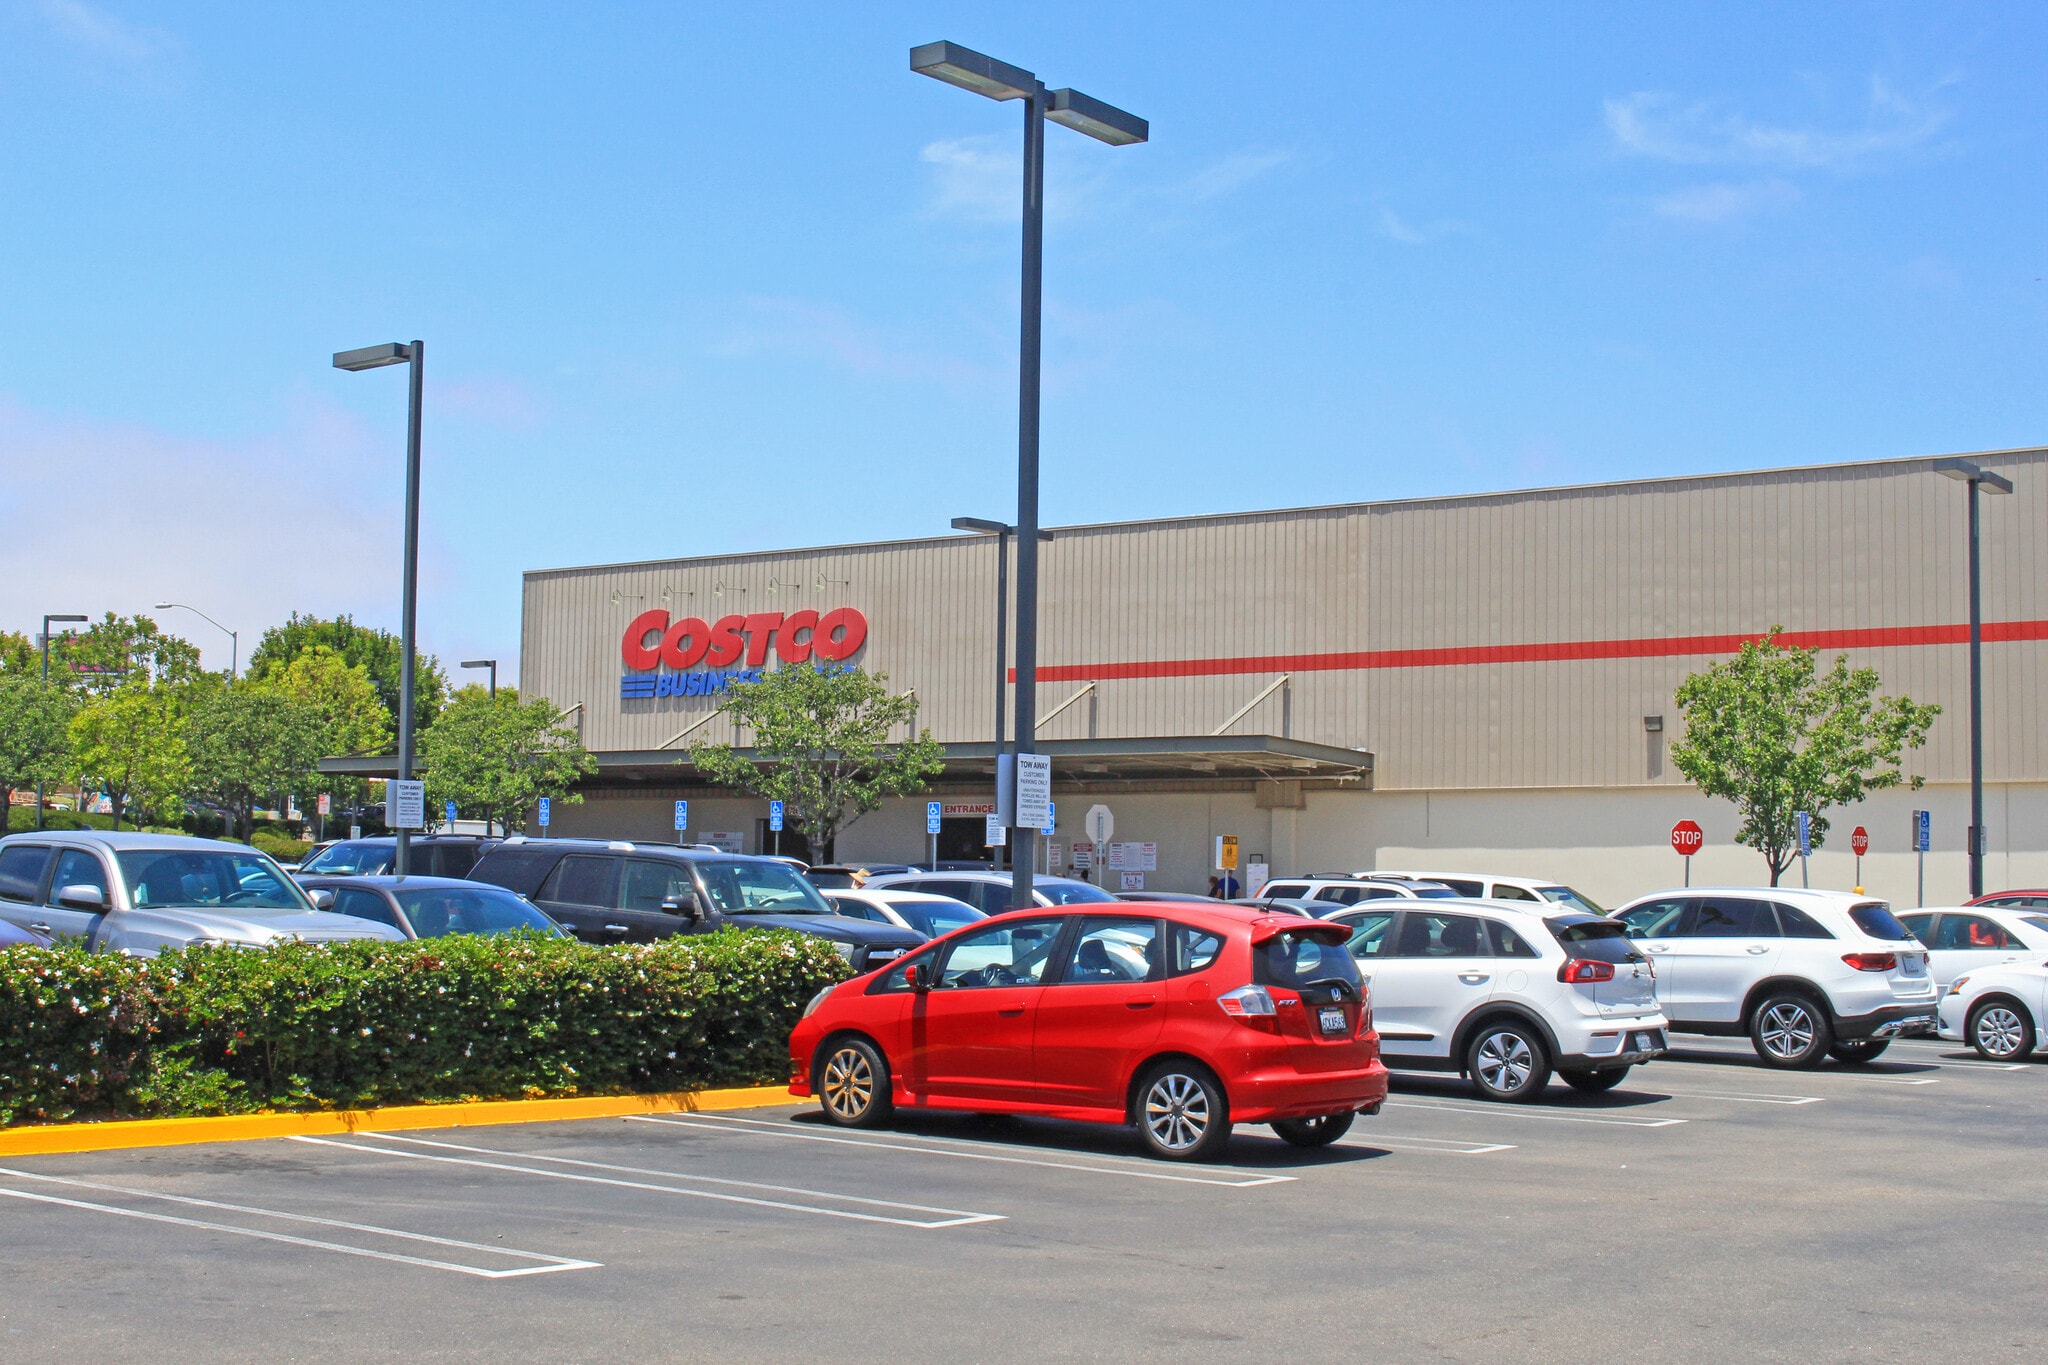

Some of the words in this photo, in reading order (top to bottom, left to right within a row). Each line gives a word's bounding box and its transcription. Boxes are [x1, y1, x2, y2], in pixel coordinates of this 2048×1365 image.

[621, 607, 868, 671] COSTCO
[1020, 760, 1033, 769] TOW
[1033, 761, 1049, 770] AWAY
[944, 804, 994, 814] ENTRANCE
[1672, 830, 1701, 845] STOP
[1852, 835, 1867, 847] STOP
